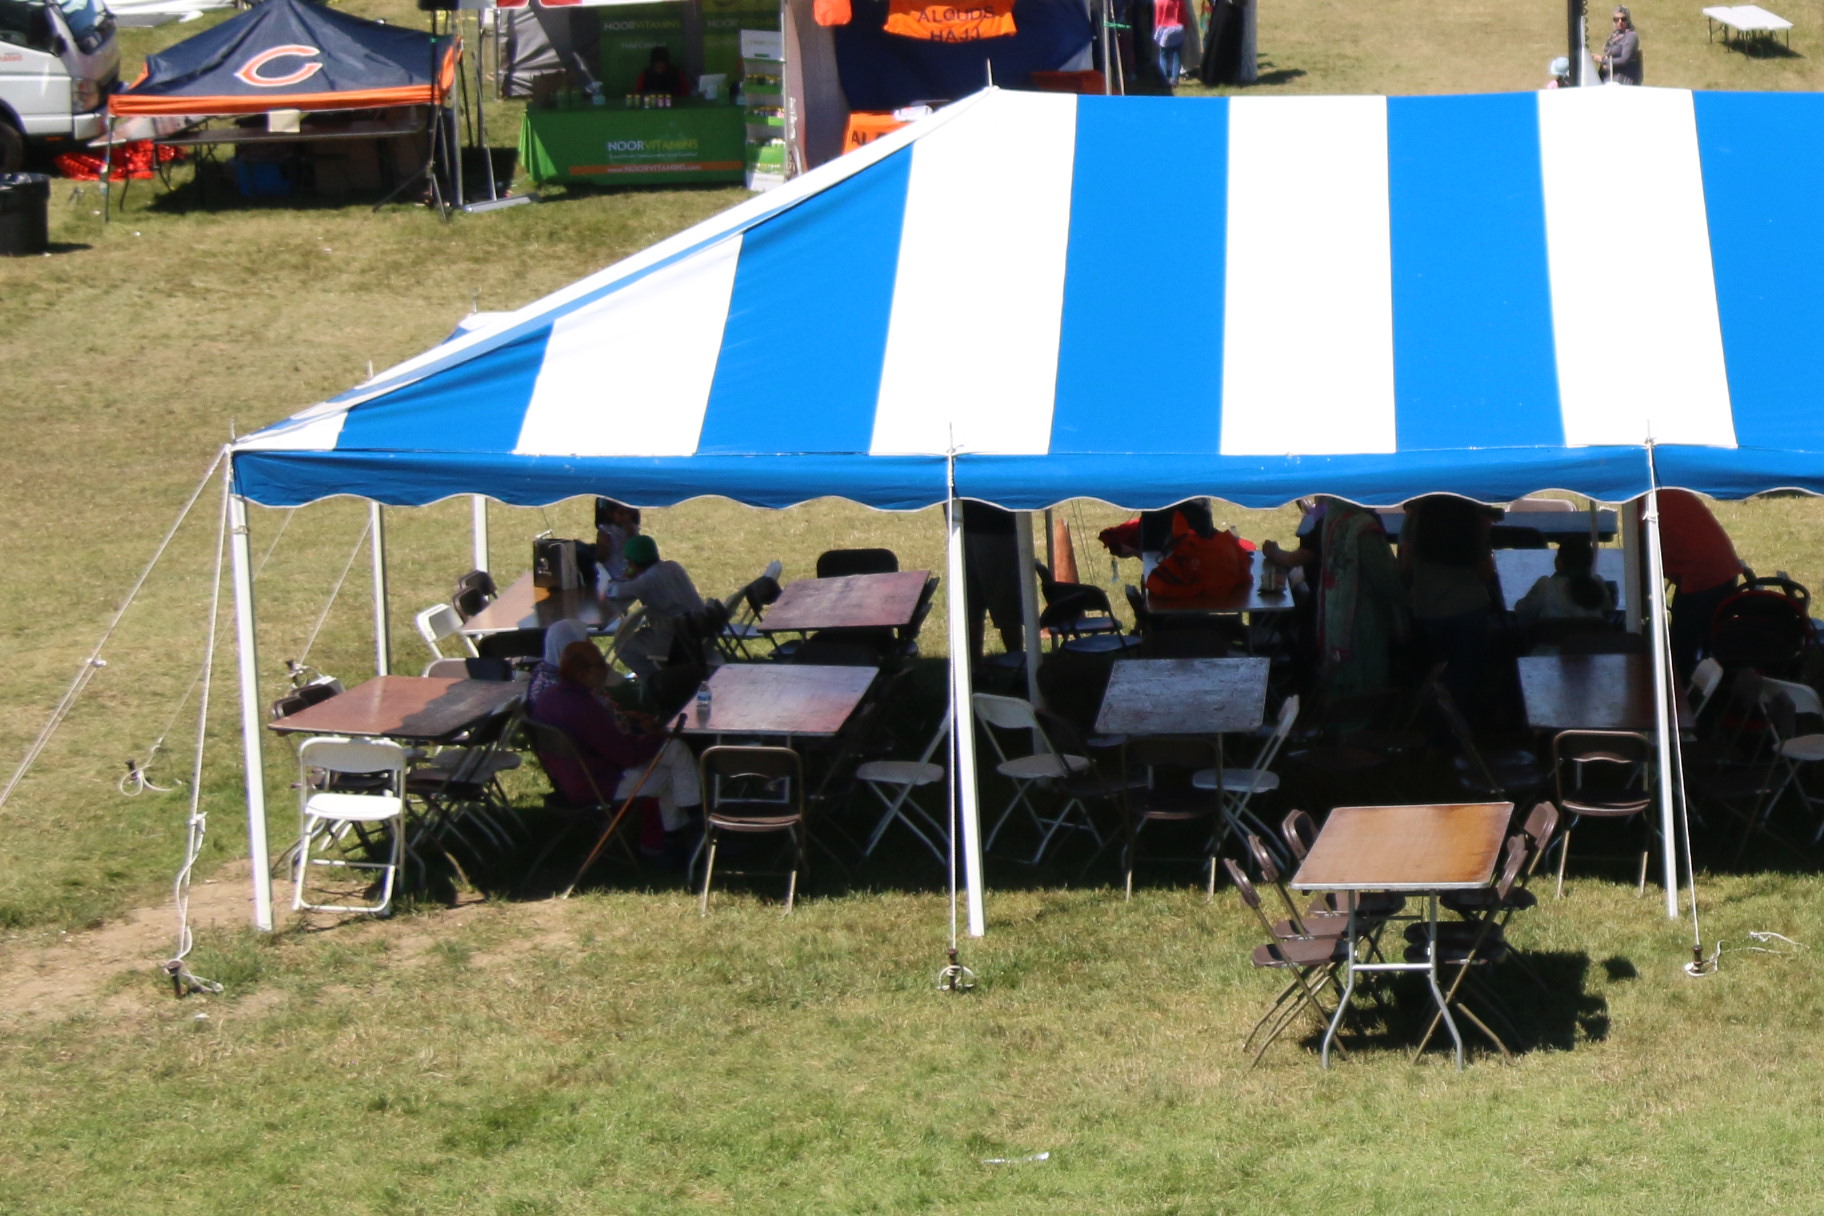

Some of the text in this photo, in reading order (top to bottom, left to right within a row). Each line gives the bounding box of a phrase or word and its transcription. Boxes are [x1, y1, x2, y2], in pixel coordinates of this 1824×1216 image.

[929, 27, 982, 43] HAJJ
[235, 44, 323, 87] C
[608, 138, 698, 152] NOORVITAMINS
